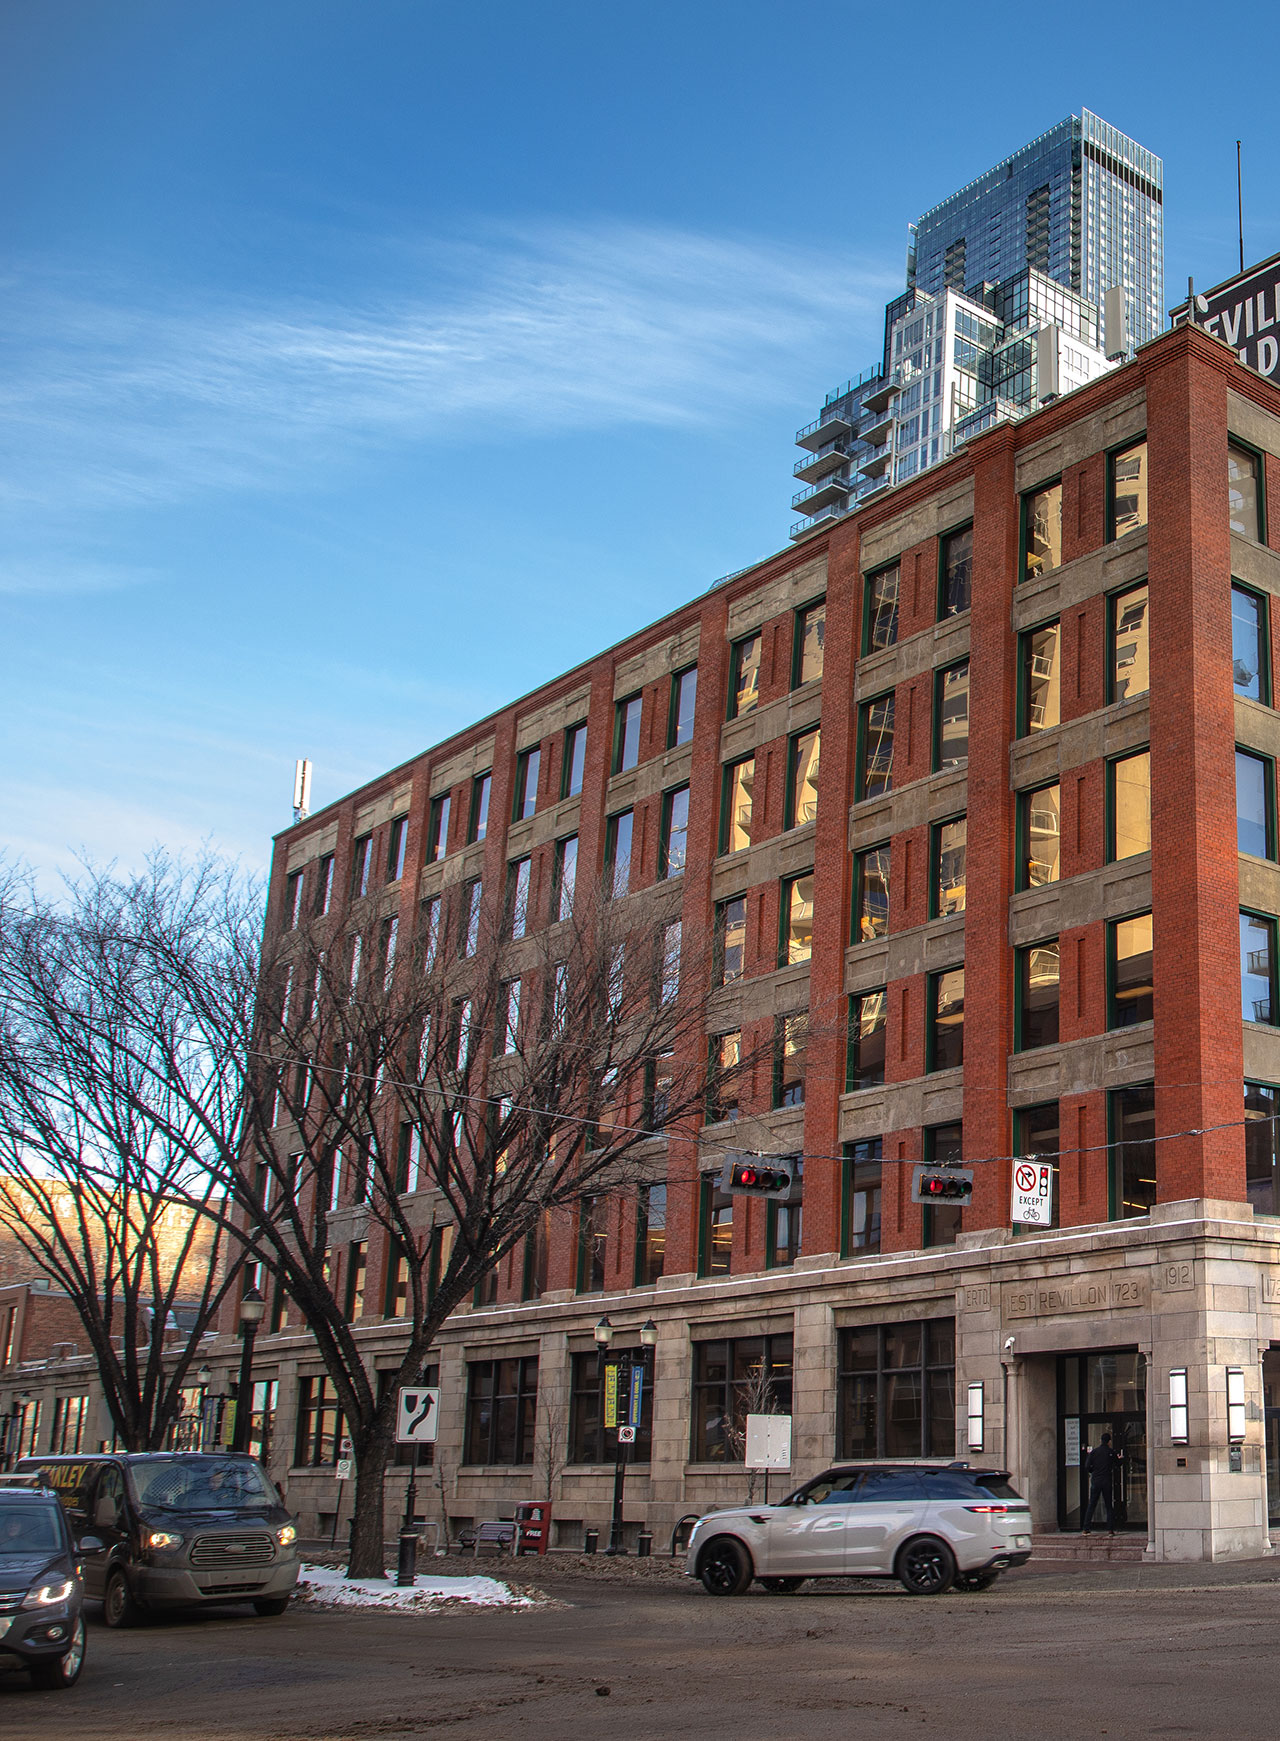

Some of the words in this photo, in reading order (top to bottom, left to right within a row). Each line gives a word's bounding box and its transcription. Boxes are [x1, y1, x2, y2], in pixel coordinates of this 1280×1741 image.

[1019, 1195, 1044, 1206] EXCEPT
[1165, 1265, 1190, 1285] 1912
[1039, 1285, 1107, 1310] REVILLON
[1111, 1282, 1139, 1303] 1723
